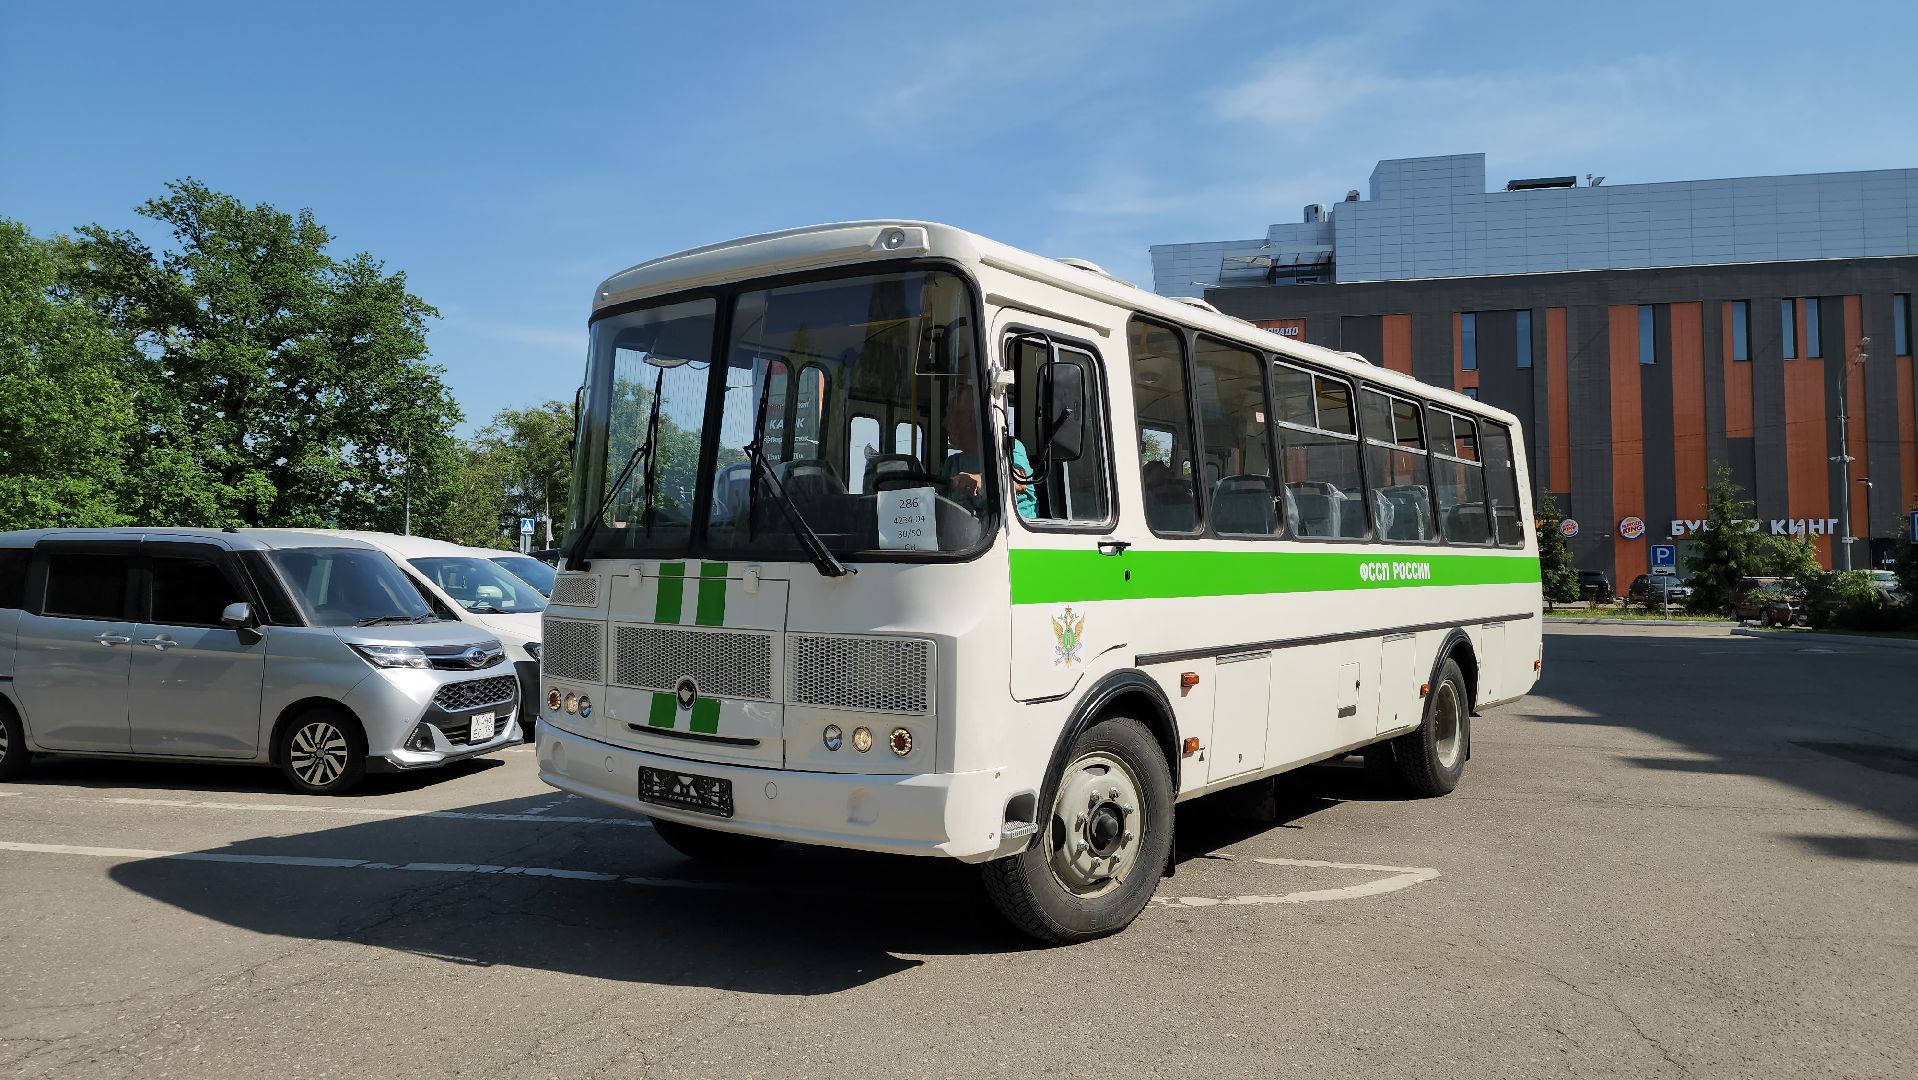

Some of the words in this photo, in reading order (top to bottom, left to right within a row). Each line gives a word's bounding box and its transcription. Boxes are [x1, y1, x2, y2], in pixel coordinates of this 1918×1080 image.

[899, 497, 919, 509] 286
[898, 528, 922, 539] 30/50
[1622, 525, 1643, 535] KING
[1770, 518, 1839, 536] КИНГ
[1657, 547, 1670, 564] P
[1359, 562, 1390, 581] ФССП
[1392, 561, 1431, 580] РОССИИ
